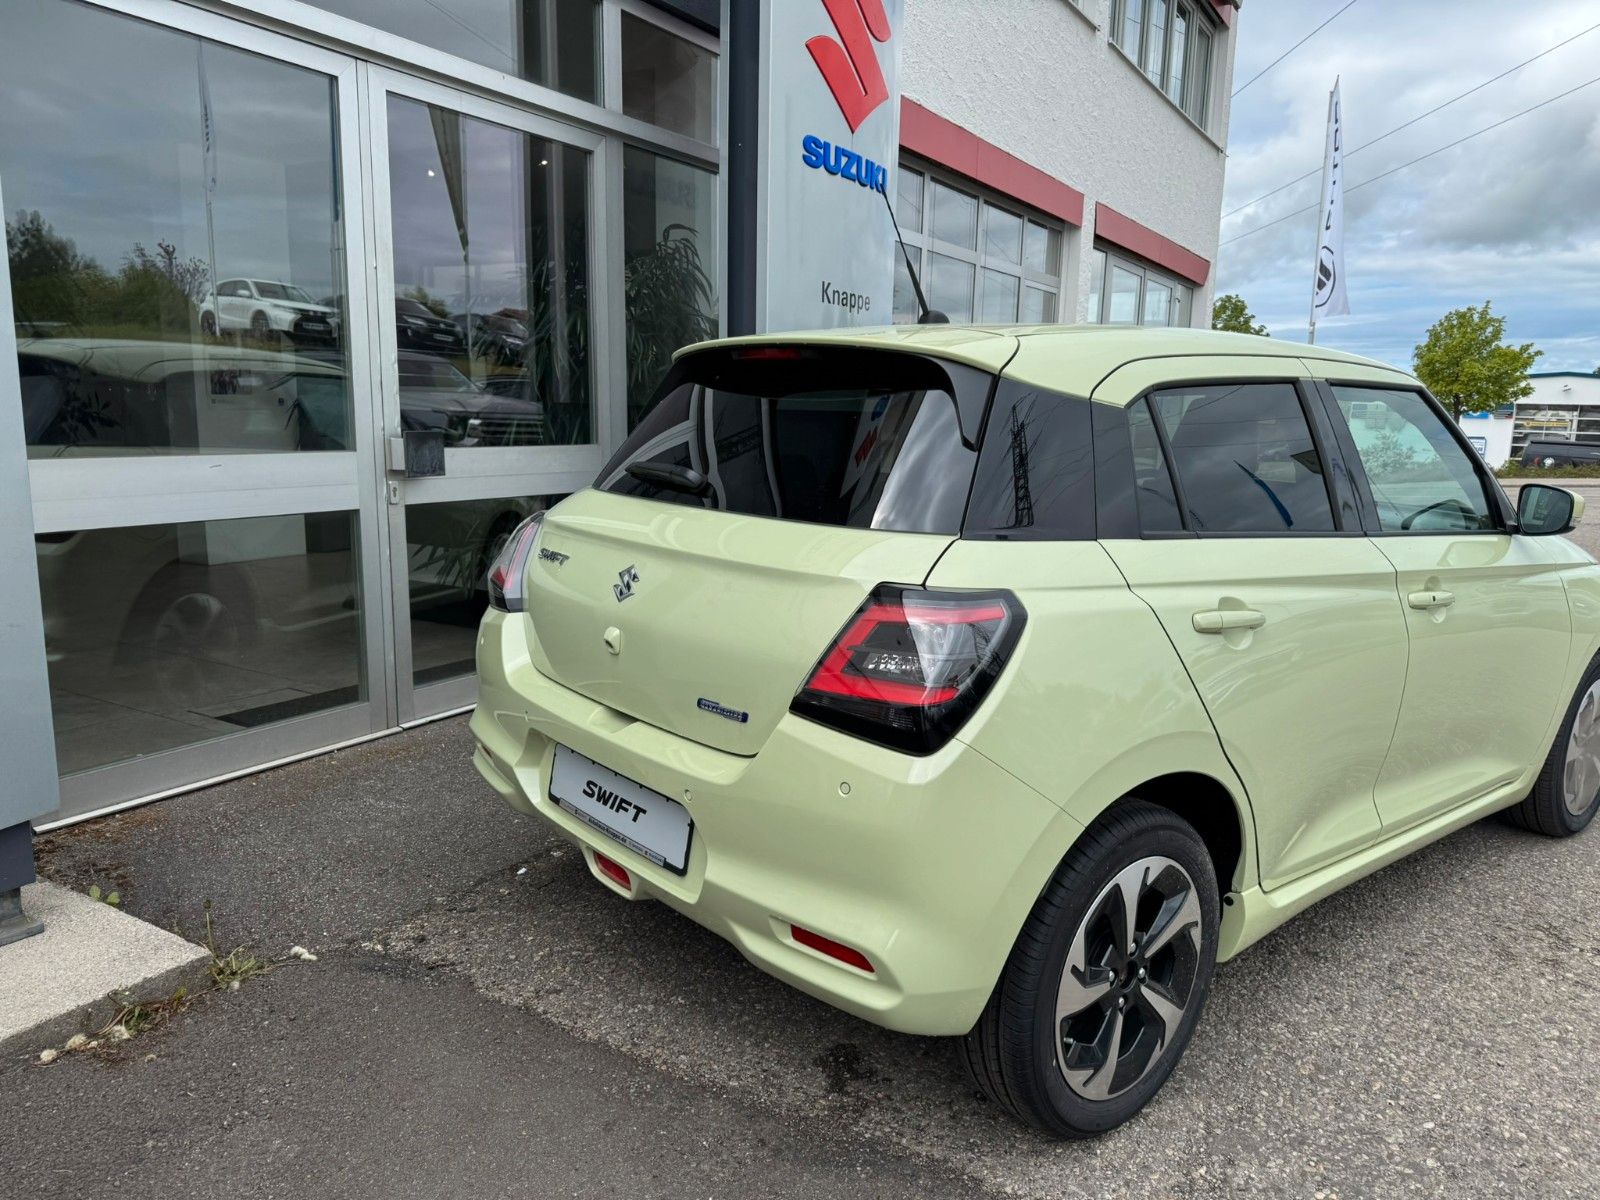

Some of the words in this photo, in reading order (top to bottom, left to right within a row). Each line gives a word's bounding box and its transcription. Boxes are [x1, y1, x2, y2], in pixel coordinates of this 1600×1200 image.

[802, 134, 888, 194] SUZUKI
[821, 281, 870, 314] Knappe
[538, 547, 570, 566] SWIFT
[582, 780, 647, 823] SWIFT
